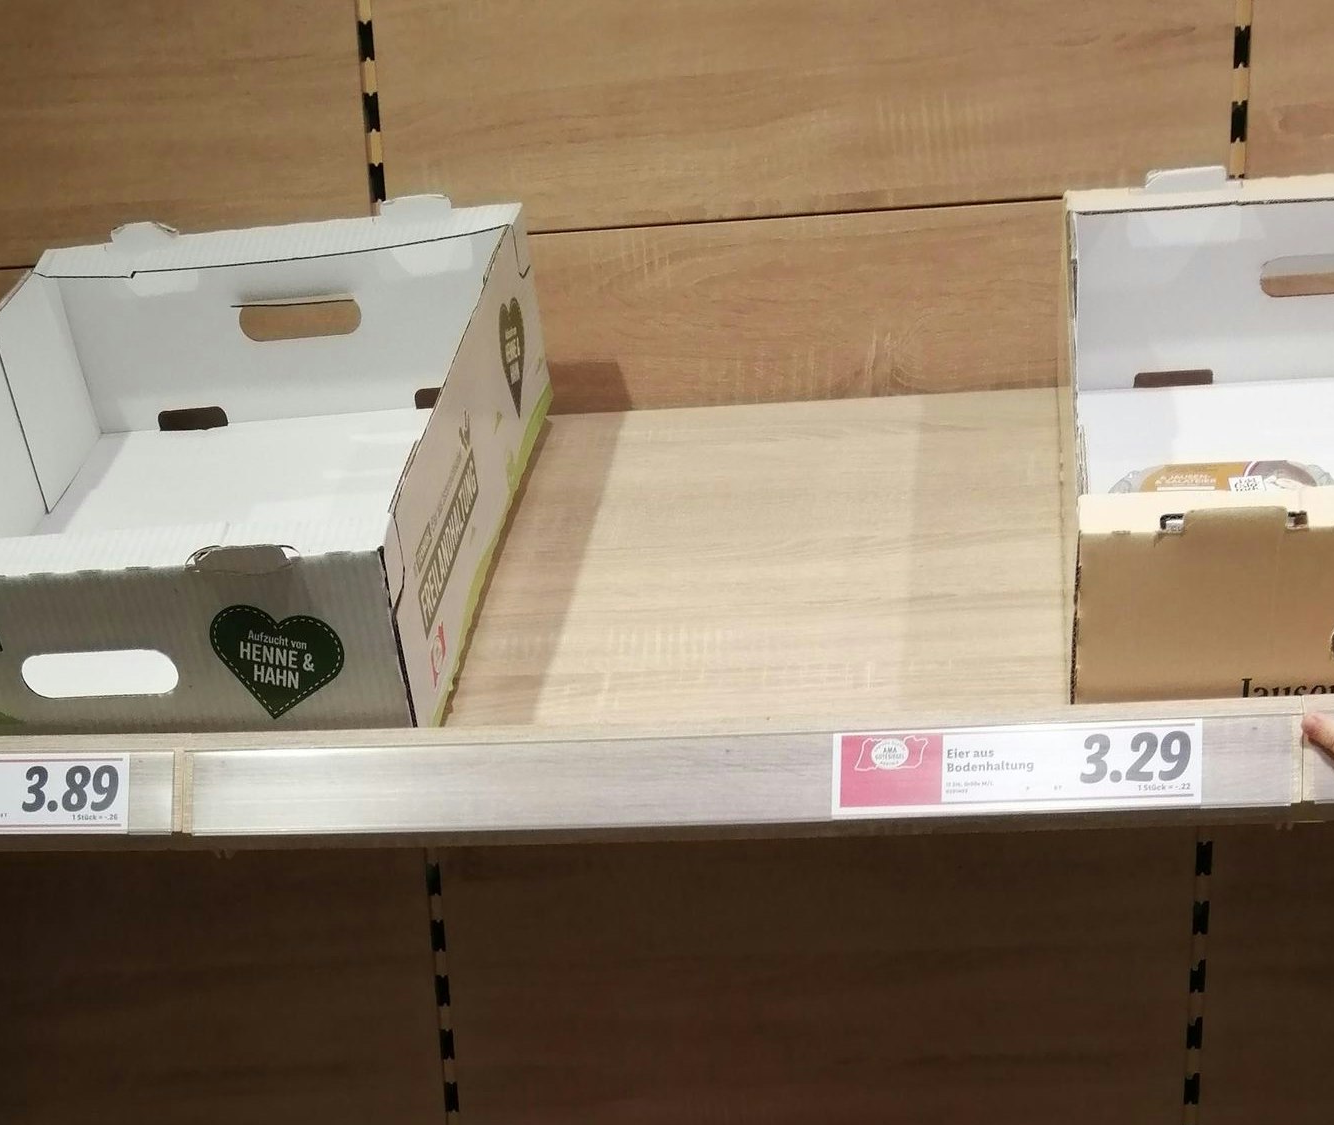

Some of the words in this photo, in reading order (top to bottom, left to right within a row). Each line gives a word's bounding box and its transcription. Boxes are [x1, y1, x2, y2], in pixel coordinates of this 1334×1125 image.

[421, 460, 477, 628] FREILANDHALTUNG
[248, 630, 288, 647] Aufzucht
[290, 640, 307, 650] von
[239, 640, 298, 669] HENNE
[302, 653, 315, 672] &
[253, 663, 299, 689] HAHN
[946, 748, 969, 759] Eier
[972, 749, 994, 758] aus
[1080, 731, 1191, 784] 3.29
[947, 761, 1034, 773] Bodenhaltung
[21, 765, 119, 813] 3.89
[1142, 783, 1166, 791] Stück
